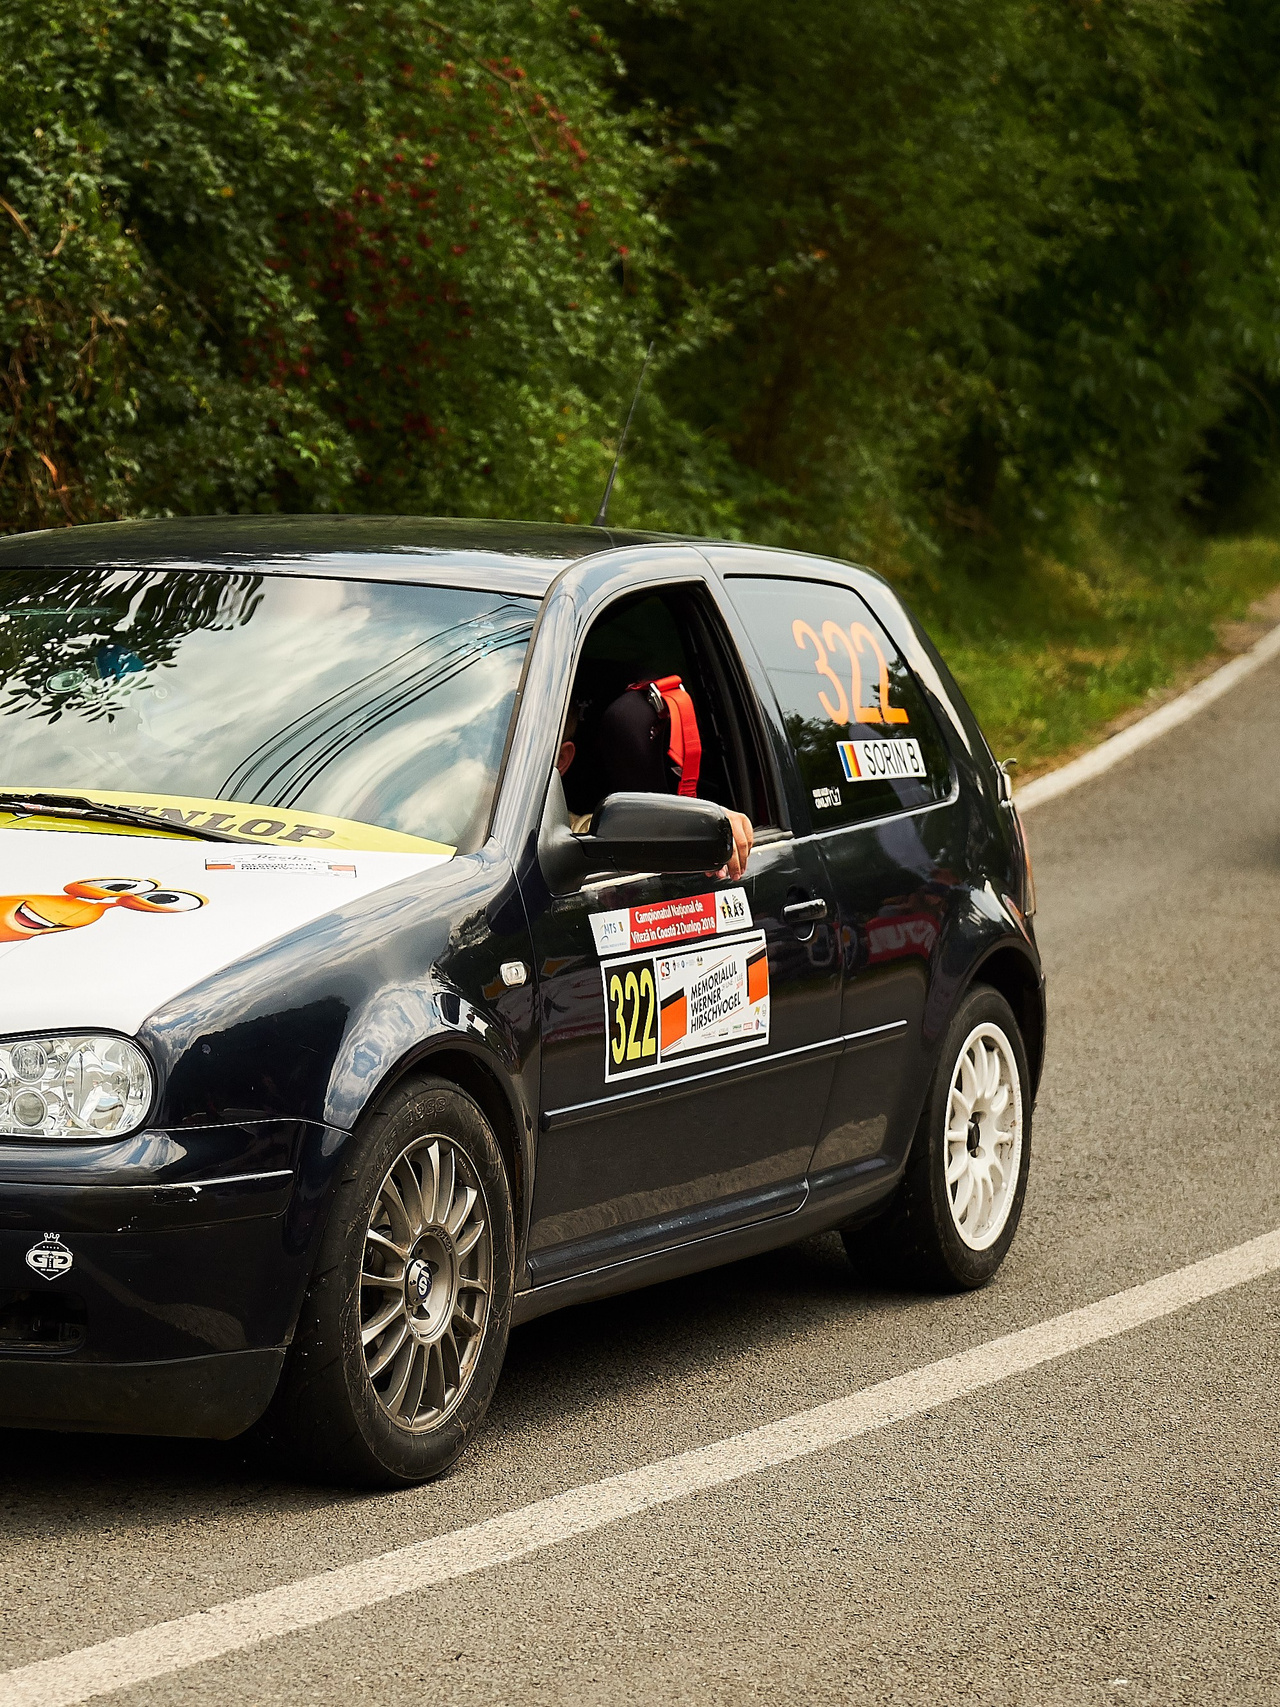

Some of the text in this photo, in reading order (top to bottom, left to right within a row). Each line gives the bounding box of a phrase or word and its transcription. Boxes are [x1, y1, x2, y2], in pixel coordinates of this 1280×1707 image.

[792, 619, 910, 726] 322
[863, 741, 908, 776] SORIN
[635, 905, 673, 925] Campionatul
[695, 899, 705, 913] de
[675, 923, 681, 936] 2
[680, 919, 701, 934] Dunlop
[700, 916, 716, 931] 2018
[690, 961, 738, 1001] MEMORIALUL
[610, 967, 656, 1065] 322
[690, 987, 722, 1017] WERNER
[690, 992, 741, 1034] HIRSCHVOGEL
